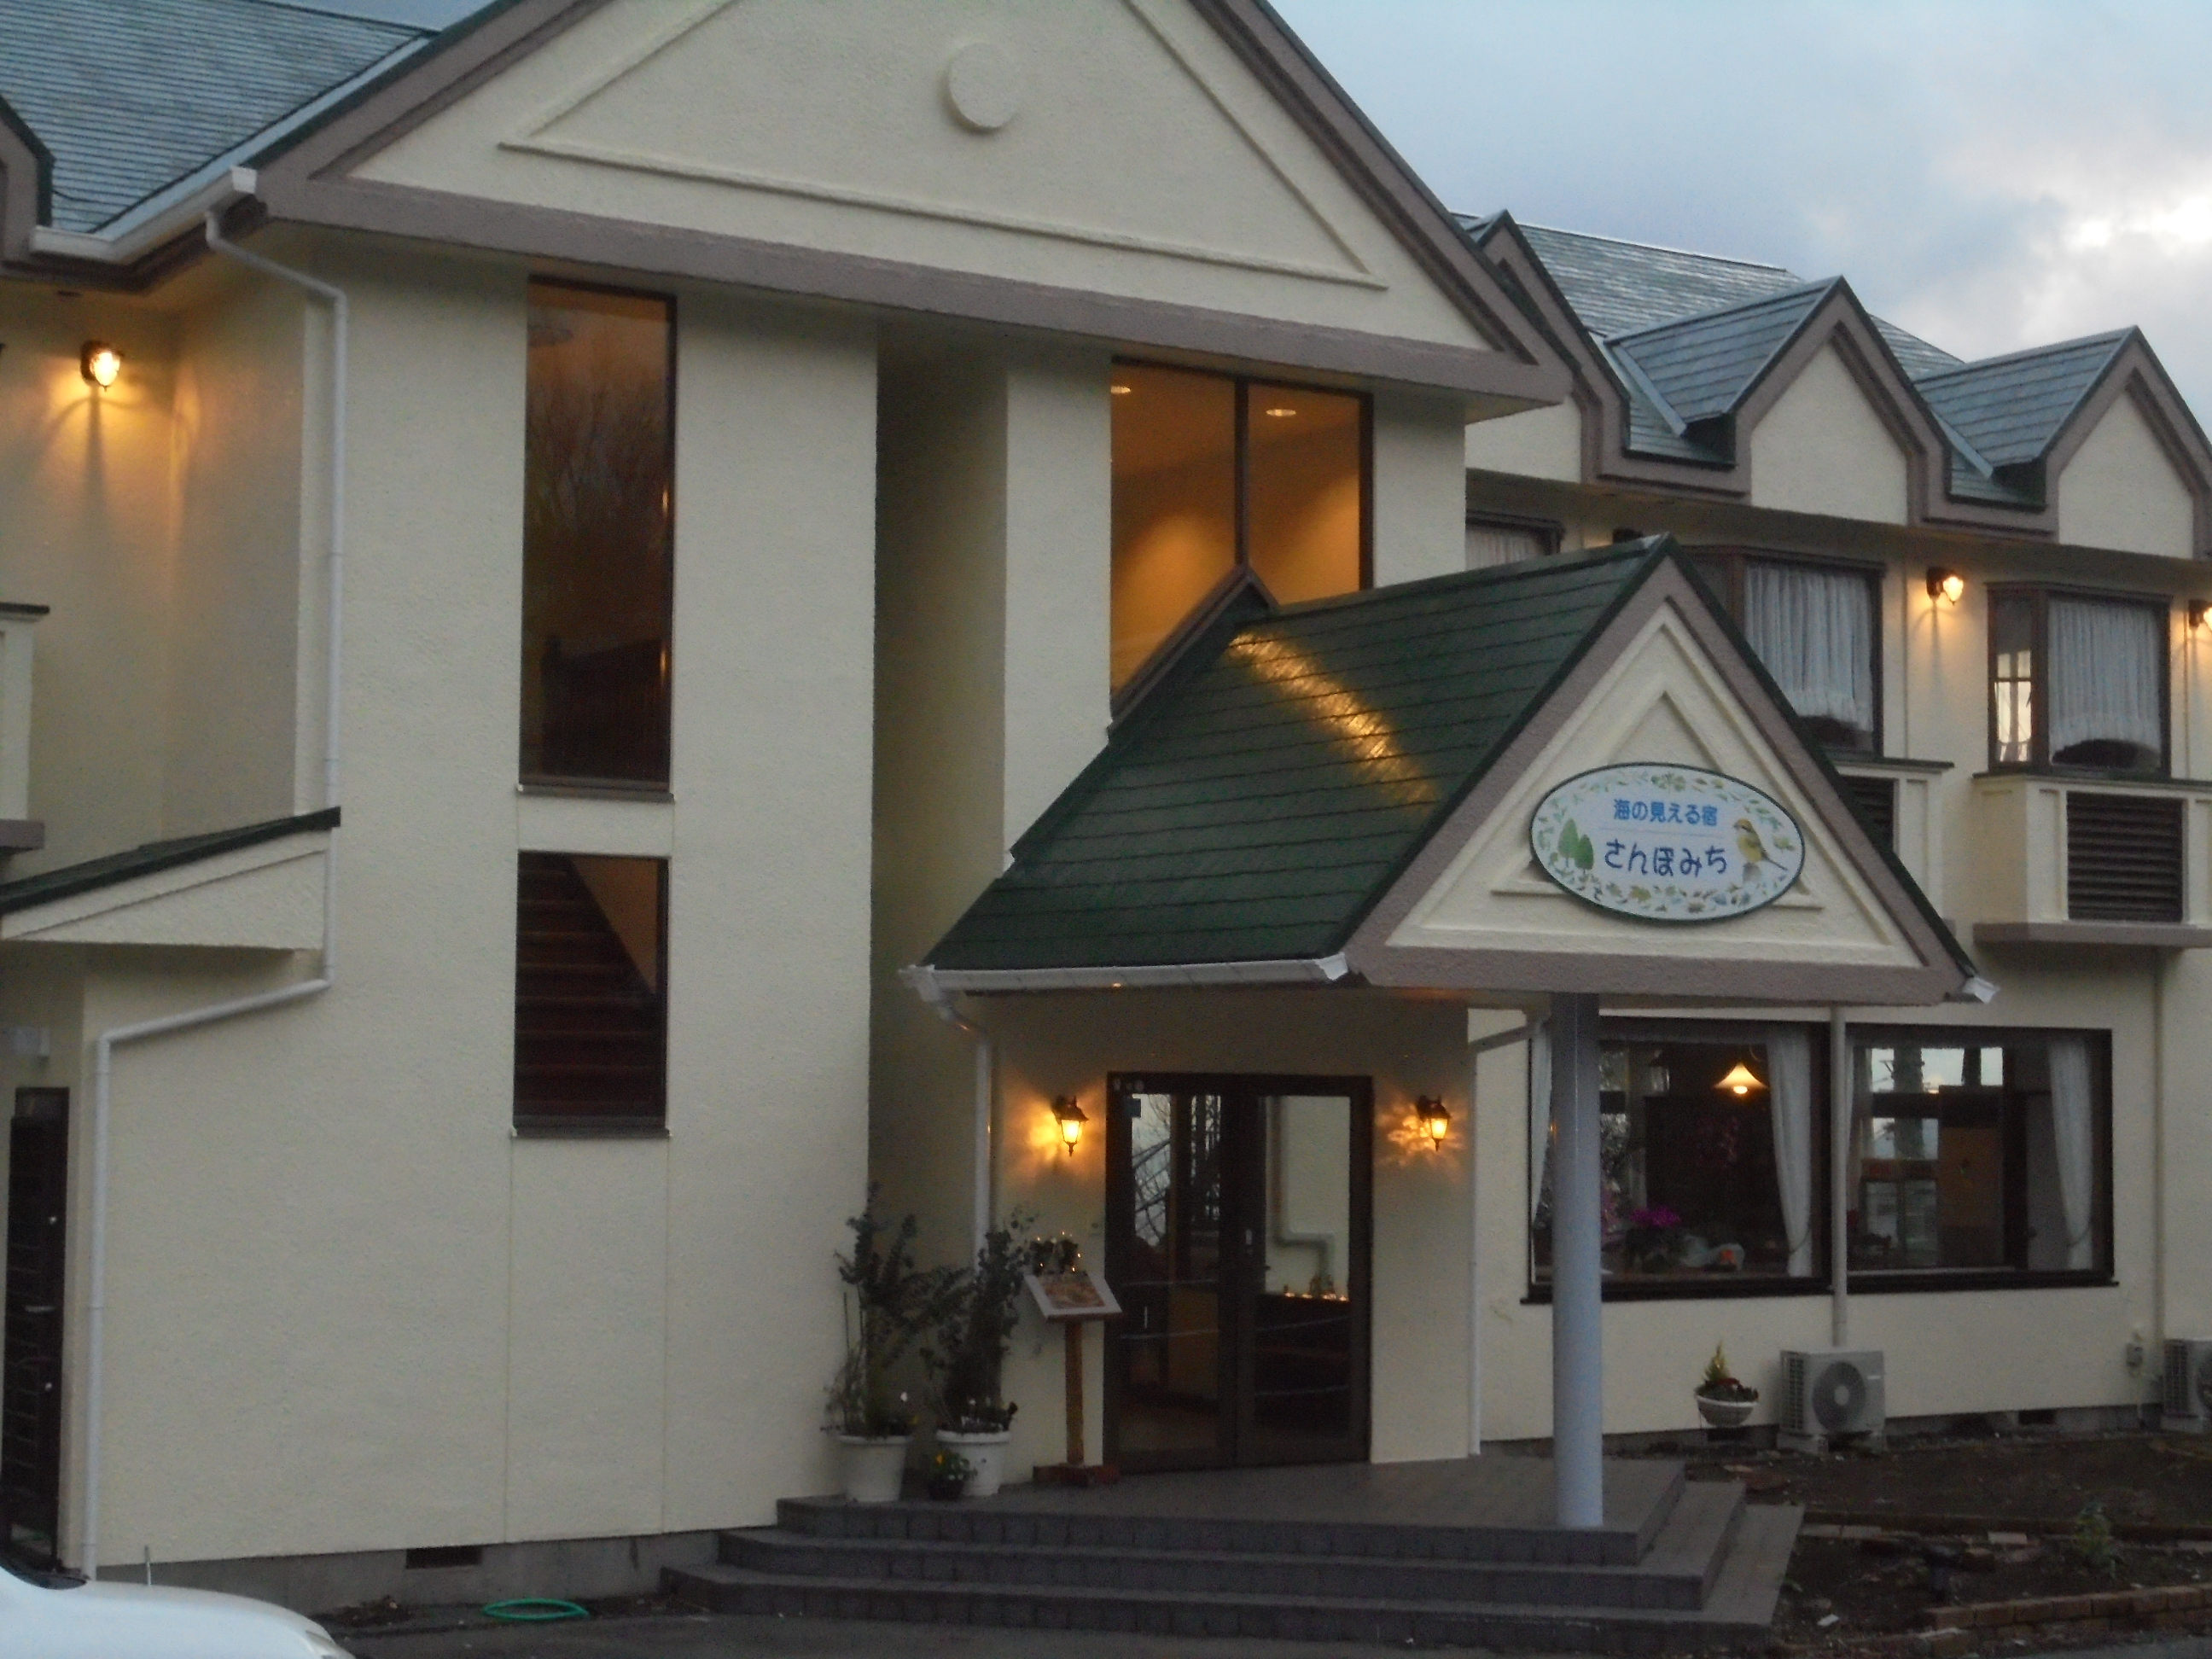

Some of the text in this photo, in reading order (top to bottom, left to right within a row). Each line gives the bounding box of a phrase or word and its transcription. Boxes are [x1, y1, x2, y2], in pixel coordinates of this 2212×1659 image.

[1614, 799, 1717, 826] 海の見える宿
